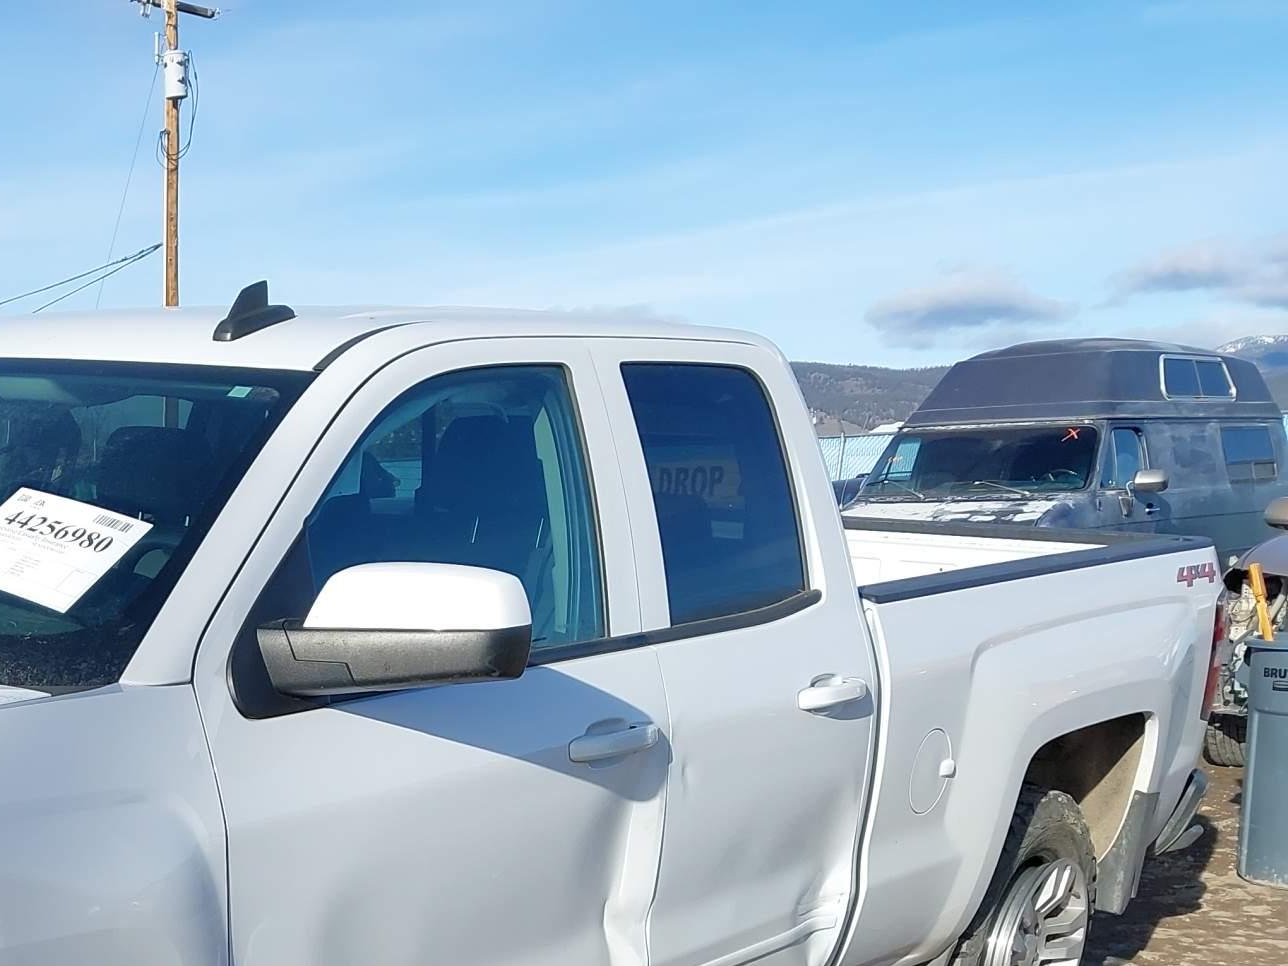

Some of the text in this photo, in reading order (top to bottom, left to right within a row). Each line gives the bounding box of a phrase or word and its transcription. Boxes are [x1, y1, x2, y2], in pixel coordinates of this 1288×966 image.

[658, 465, 724, 496] DROP
[3, 509, 114, 554] 44256980
[1263, 667, 1288, 679] BRU
